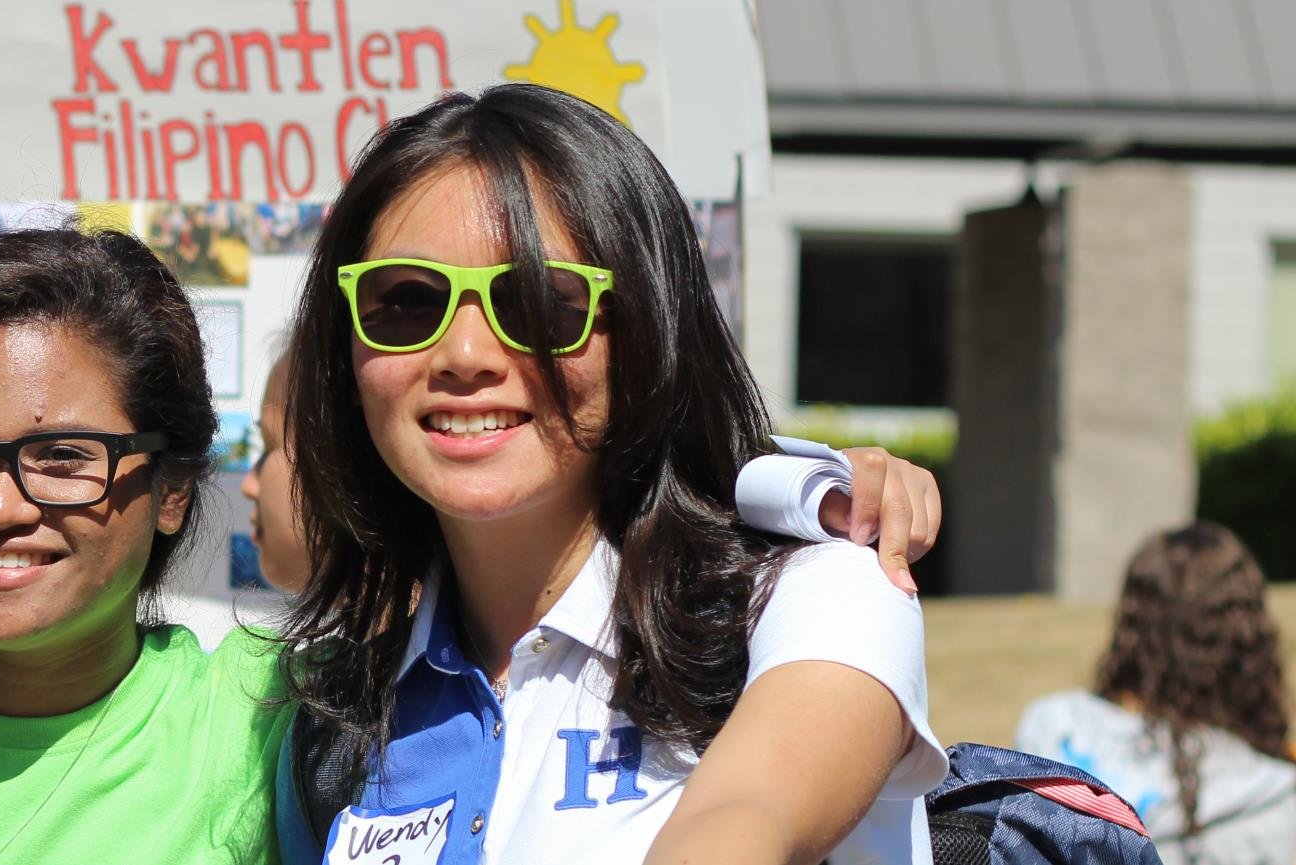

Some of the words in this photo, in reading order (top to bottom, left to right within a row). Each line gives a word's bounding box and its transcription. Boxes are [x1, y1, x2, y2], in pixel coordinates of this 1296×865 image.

[64, 0, 455, 93] Kwantlen
[50, 98, 315, 203] Filipino
[554, 726, 648, 811] H
[348, 808, 453, 860] Wendy
